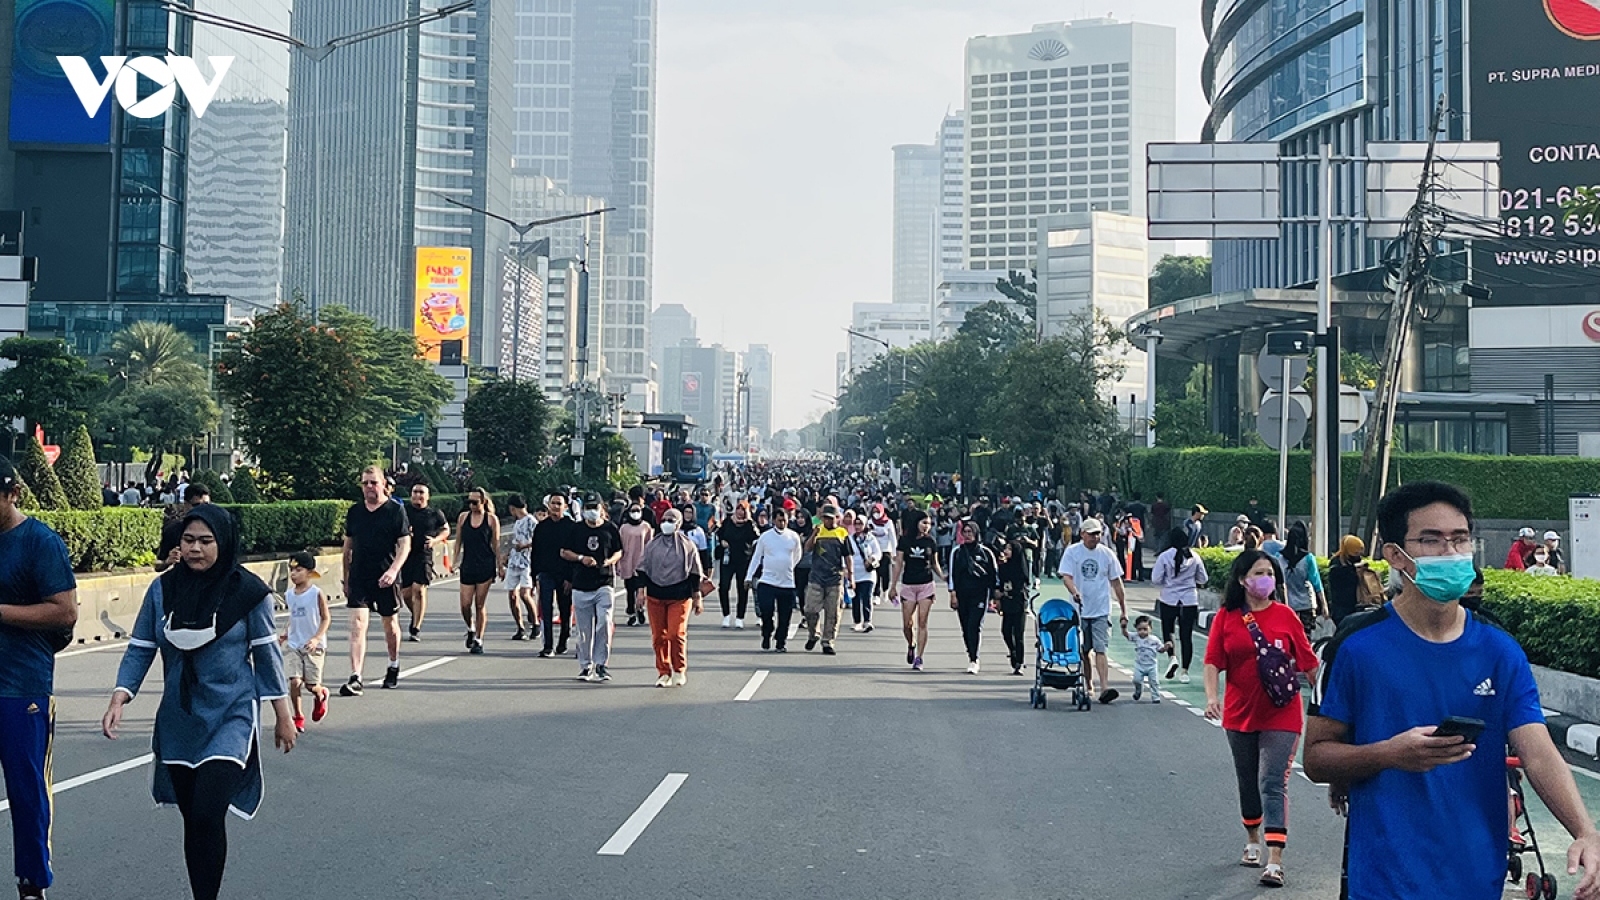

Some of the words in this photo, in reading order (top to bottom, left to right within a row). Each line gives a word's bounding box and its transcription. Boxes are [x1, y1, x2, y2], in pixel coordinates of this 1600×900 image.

[1488, 71, 1508, 83] PT.
[1511, 67, 1560, 82] SUPRA
[1564, 64, 1600, 77] MEDI
[1529, 143, 1600, 163] CONTA
[1563, 214, 1600, 236] 53
